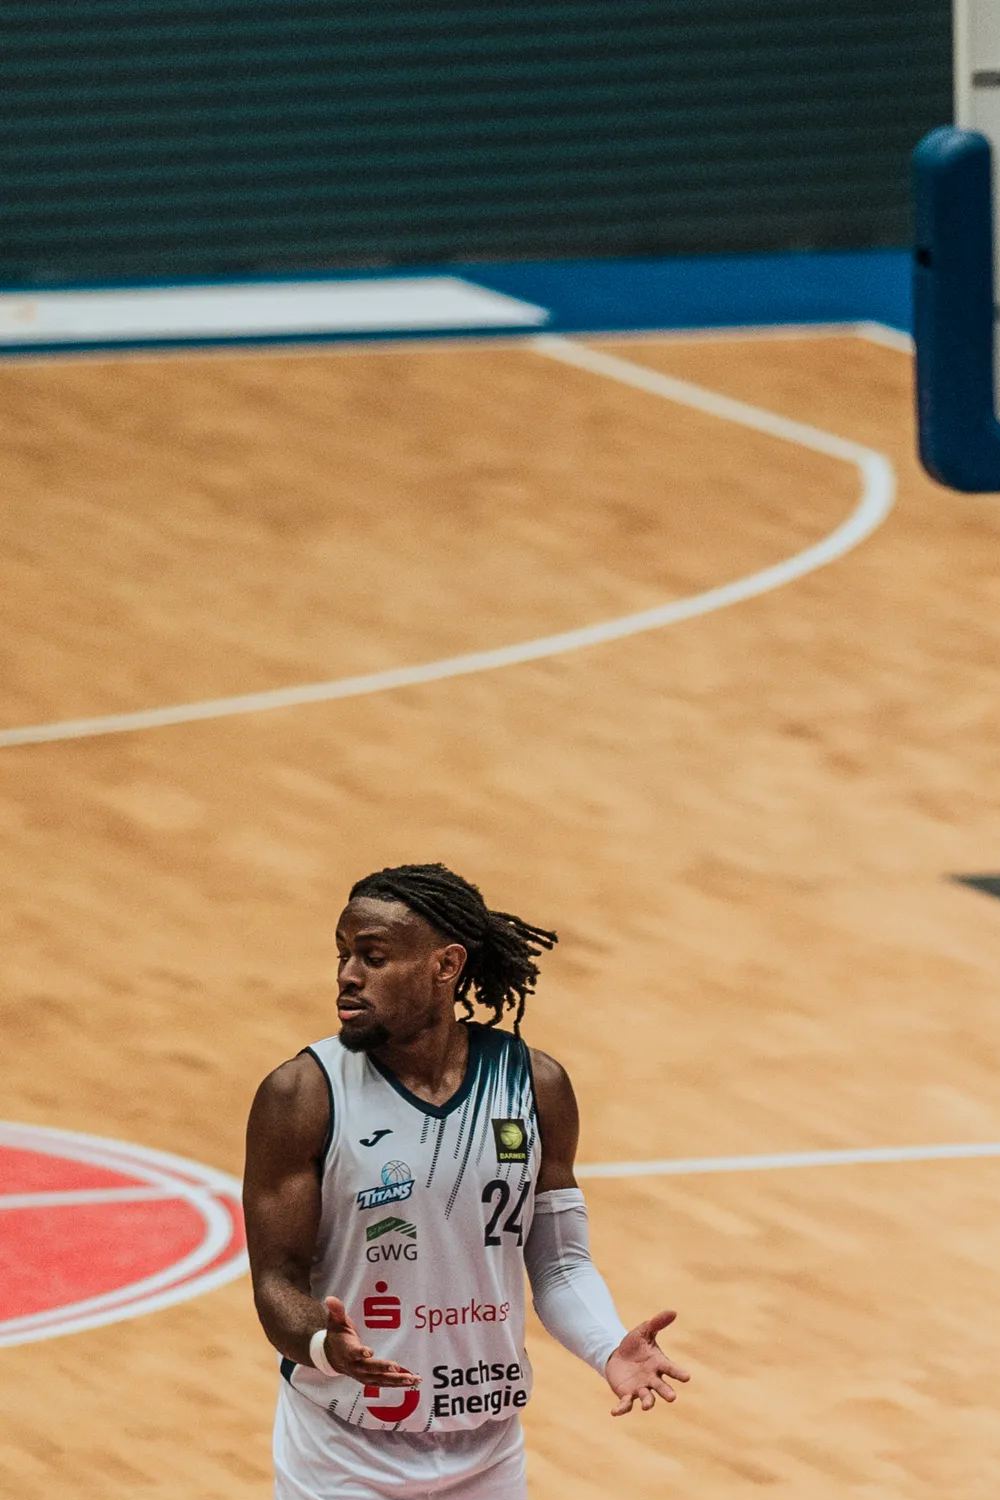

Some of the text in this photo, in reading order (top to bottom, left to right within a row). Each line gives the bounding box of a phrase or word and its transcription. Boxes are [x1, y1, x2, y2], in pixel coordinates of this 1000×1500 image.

[499, 1152, 527, 1160] BARMER
[481, 1179, 531, 1247] 24
[366, 1244, 417, 1262] GWG
[414, 1299, 510, 1333] Sparkas
[432, 1360, 524, 1389] Sachse
[434, 1386, 527, 1418] Energie
